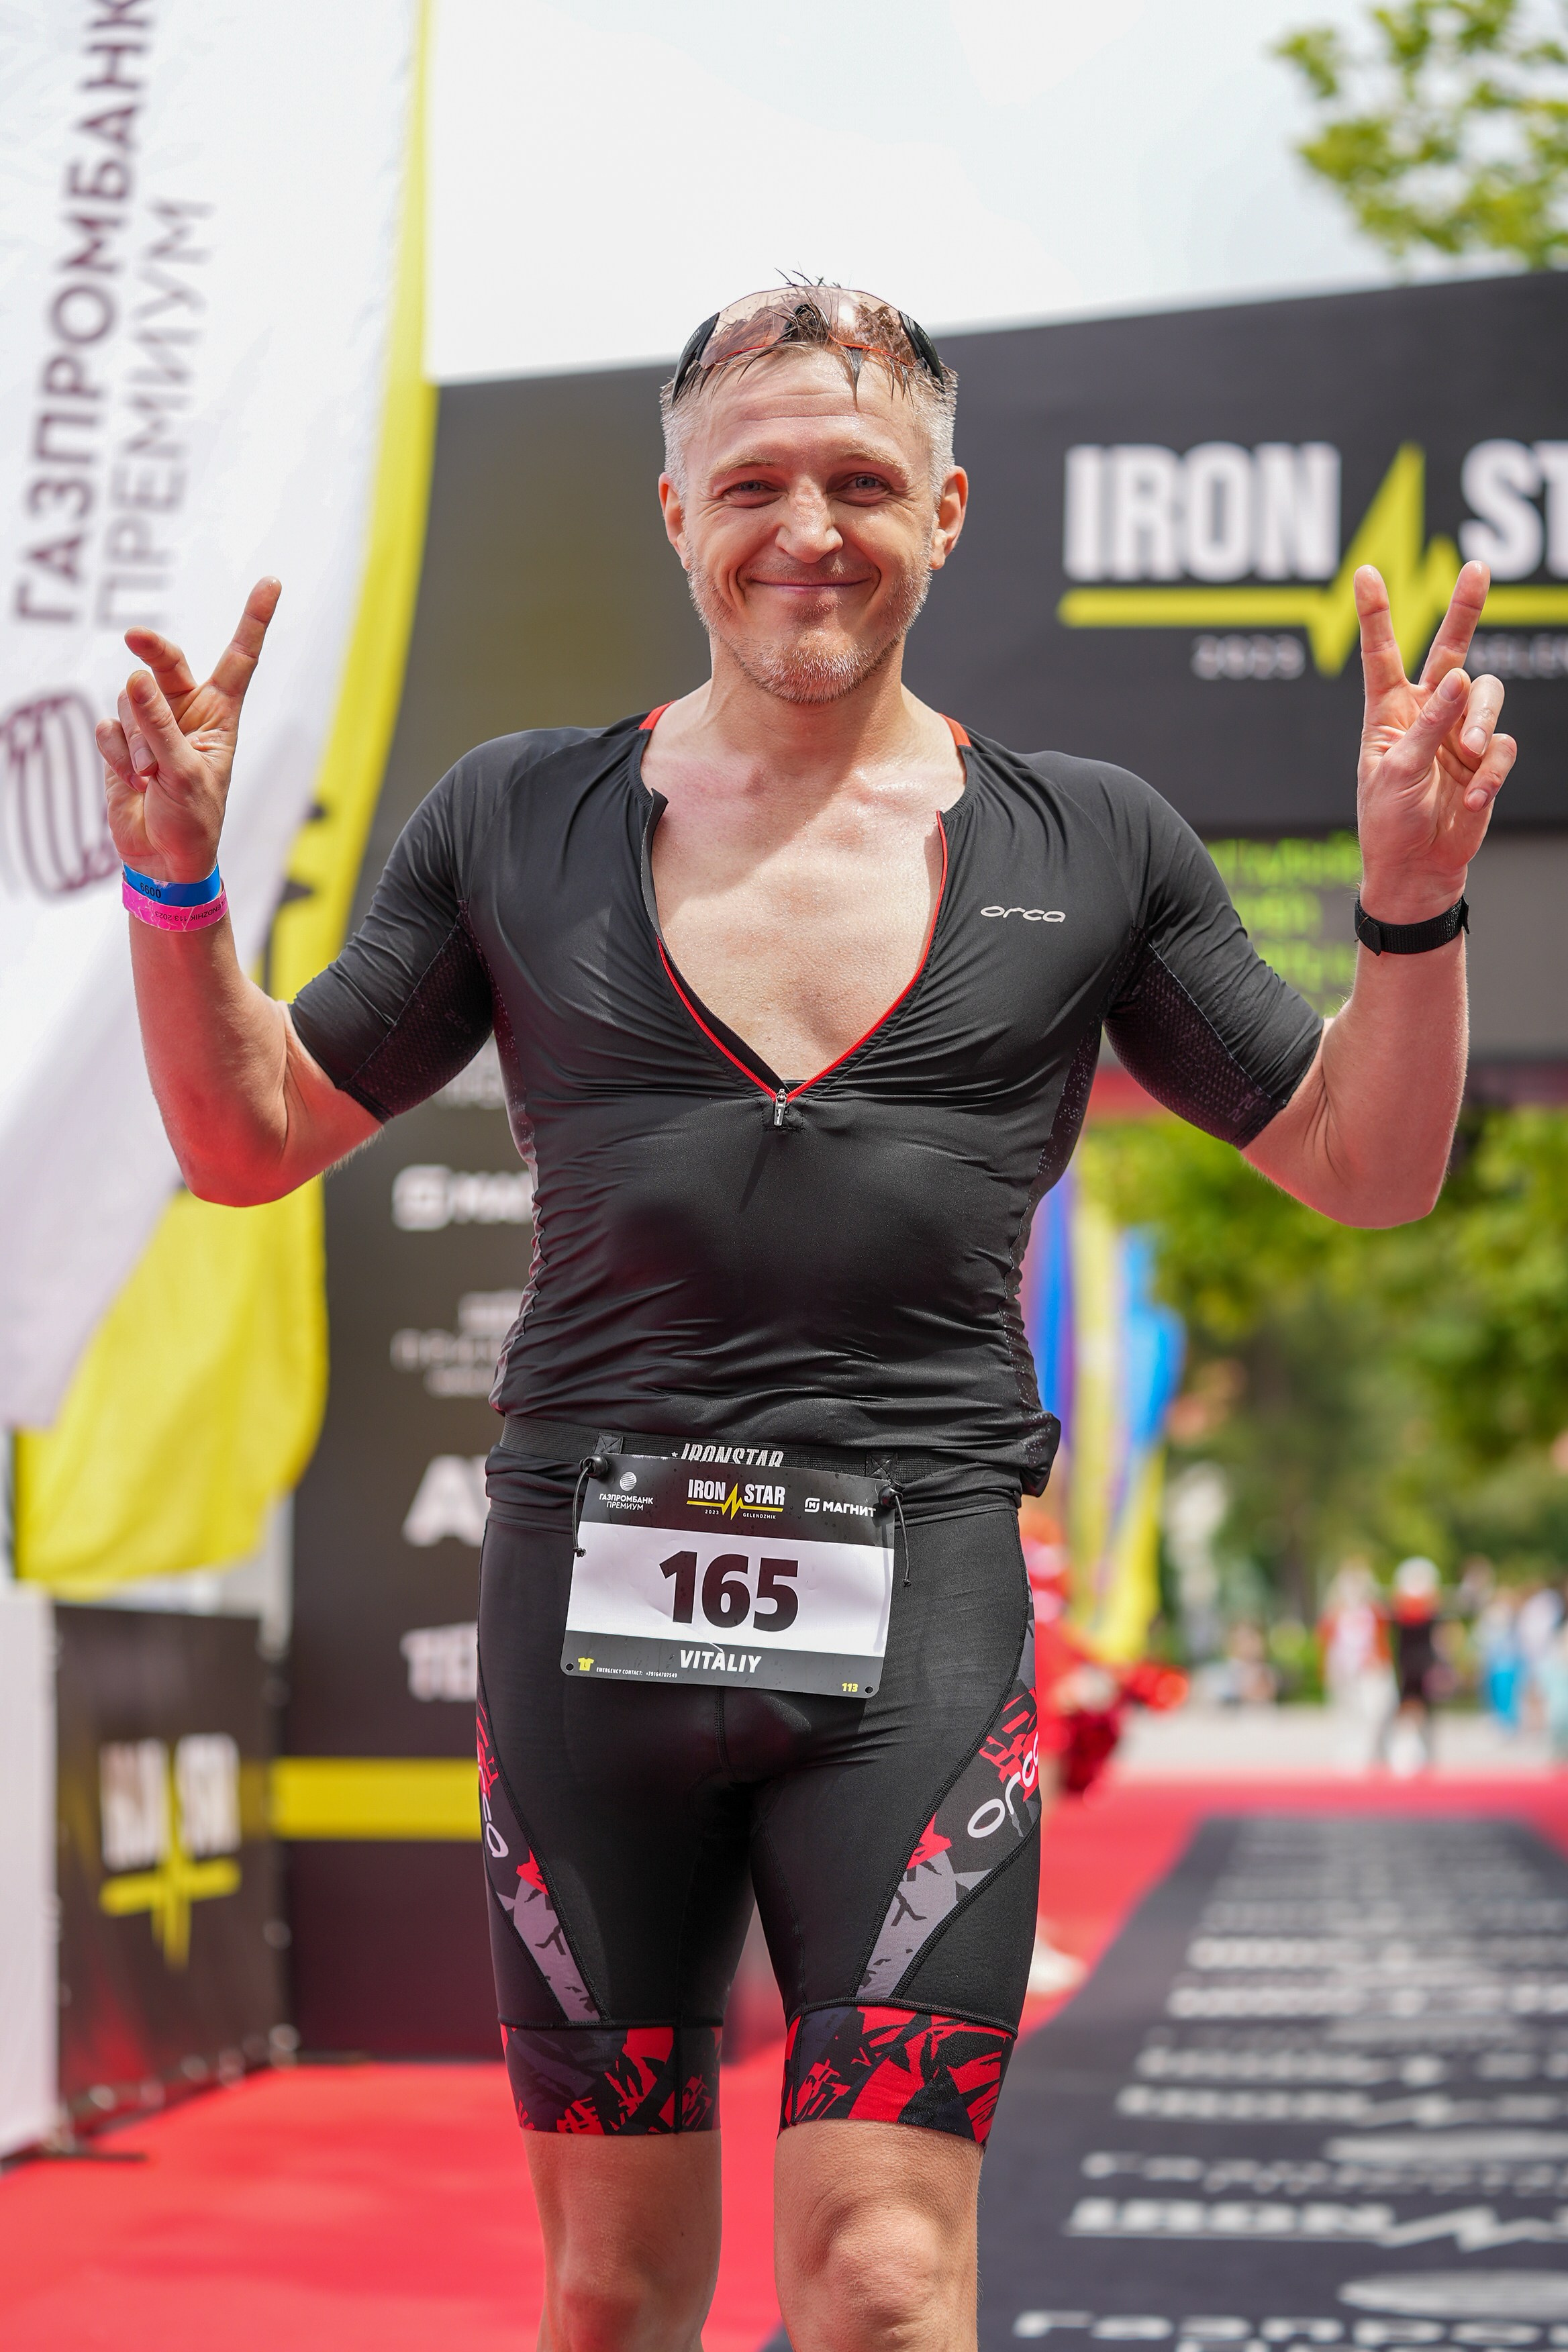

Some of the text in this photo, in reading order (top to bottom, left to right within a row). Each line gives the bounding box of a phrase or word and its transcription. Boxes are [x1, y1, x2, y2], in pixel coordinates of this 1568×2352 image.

[96, 199, 215, 632] ПРЕМИУМ
[1063, 442, 1342, 583] IRON
[155, 911, 172, 921] 2023
[980, 905, 1067, 923] orca
[681, 1443, 784, 1467] IRONSTAR
[599, 1493, 654, 1505] ГАЗПРОМБАНК
[687, 1479, 786, 1506] IRON STAR
[606, 1501, 644, 1511] ПРЕМИУМ
[822, 1501, 877, 1518] МАГНИТ
[659, 1551, 799, 1632] 165
[680, 1649, 762, 1673] VITALIY
[842, 1682, 859, 1692] 113
